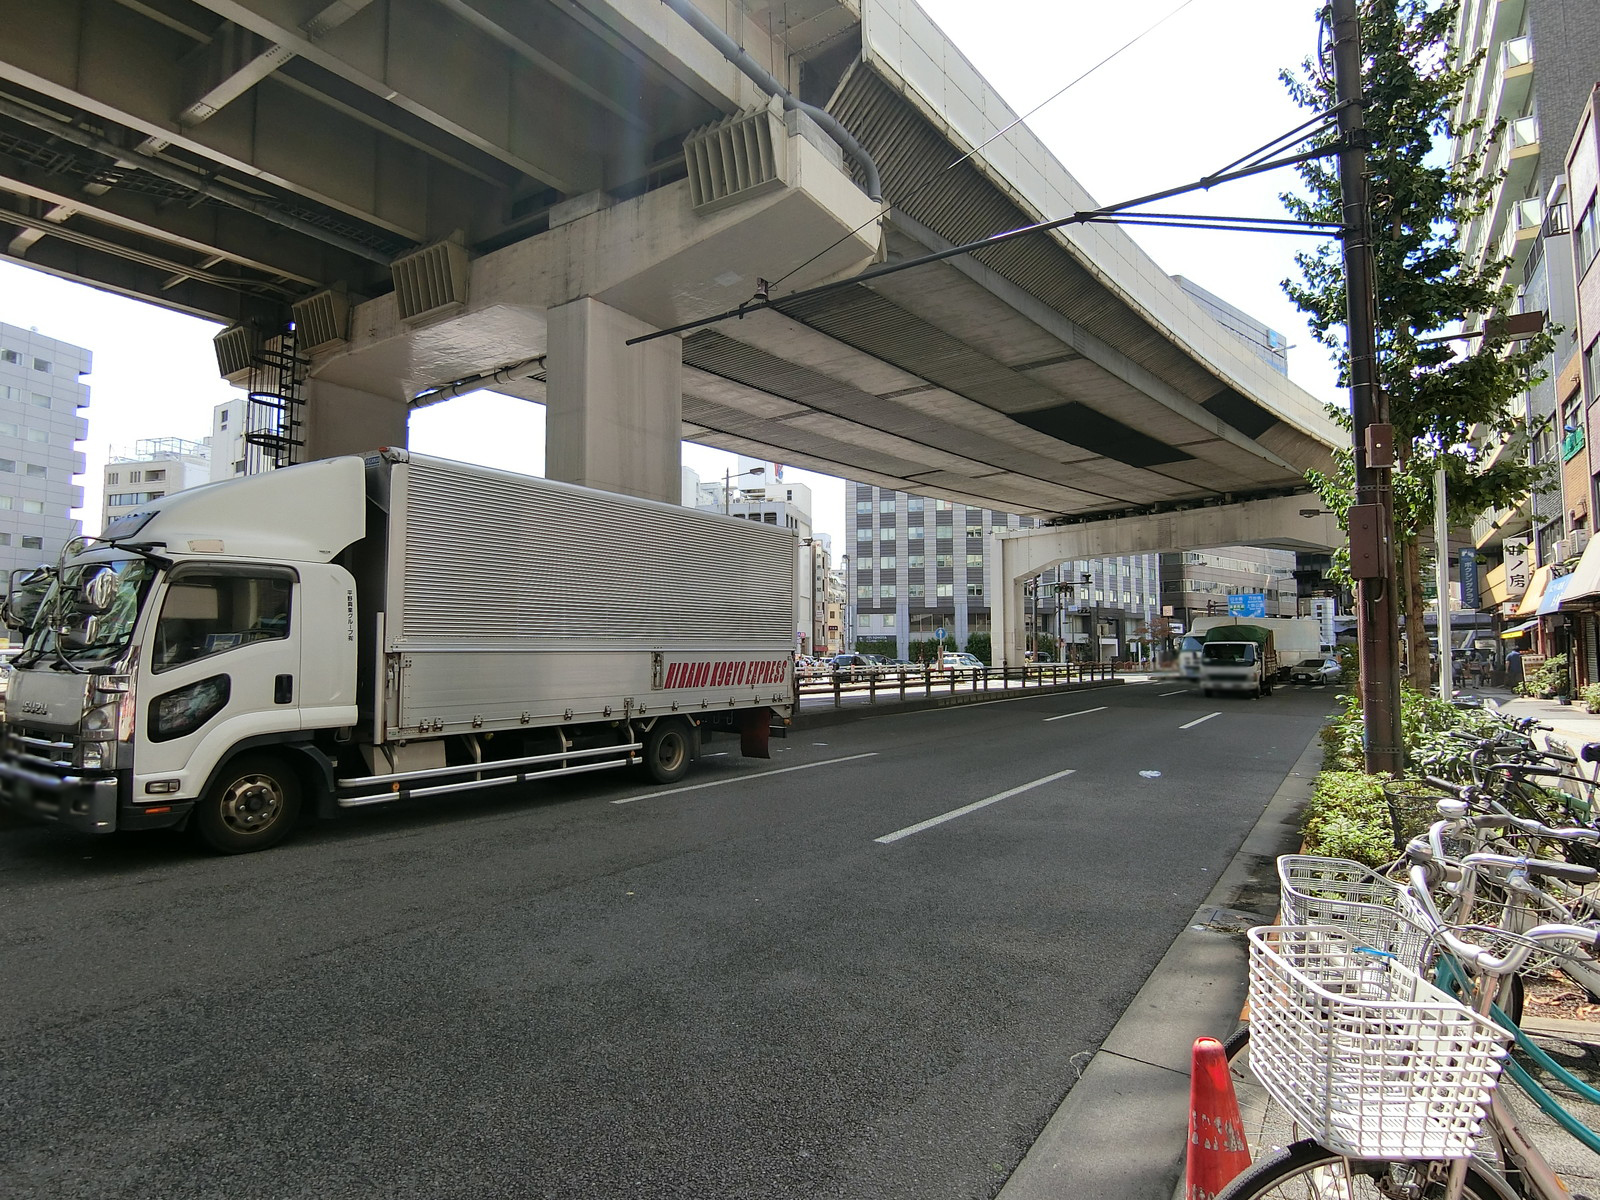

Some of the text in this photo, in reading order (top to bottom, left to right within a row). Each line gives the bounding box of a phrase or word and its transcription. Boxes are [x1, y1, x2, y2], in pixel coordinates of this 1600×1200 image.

[664, 660, 788, 690] HIRANO KOGYO EXPRESS
[22, 700, 48, 715] ISUZU
[1527, 798, 1559, 829] MERI
